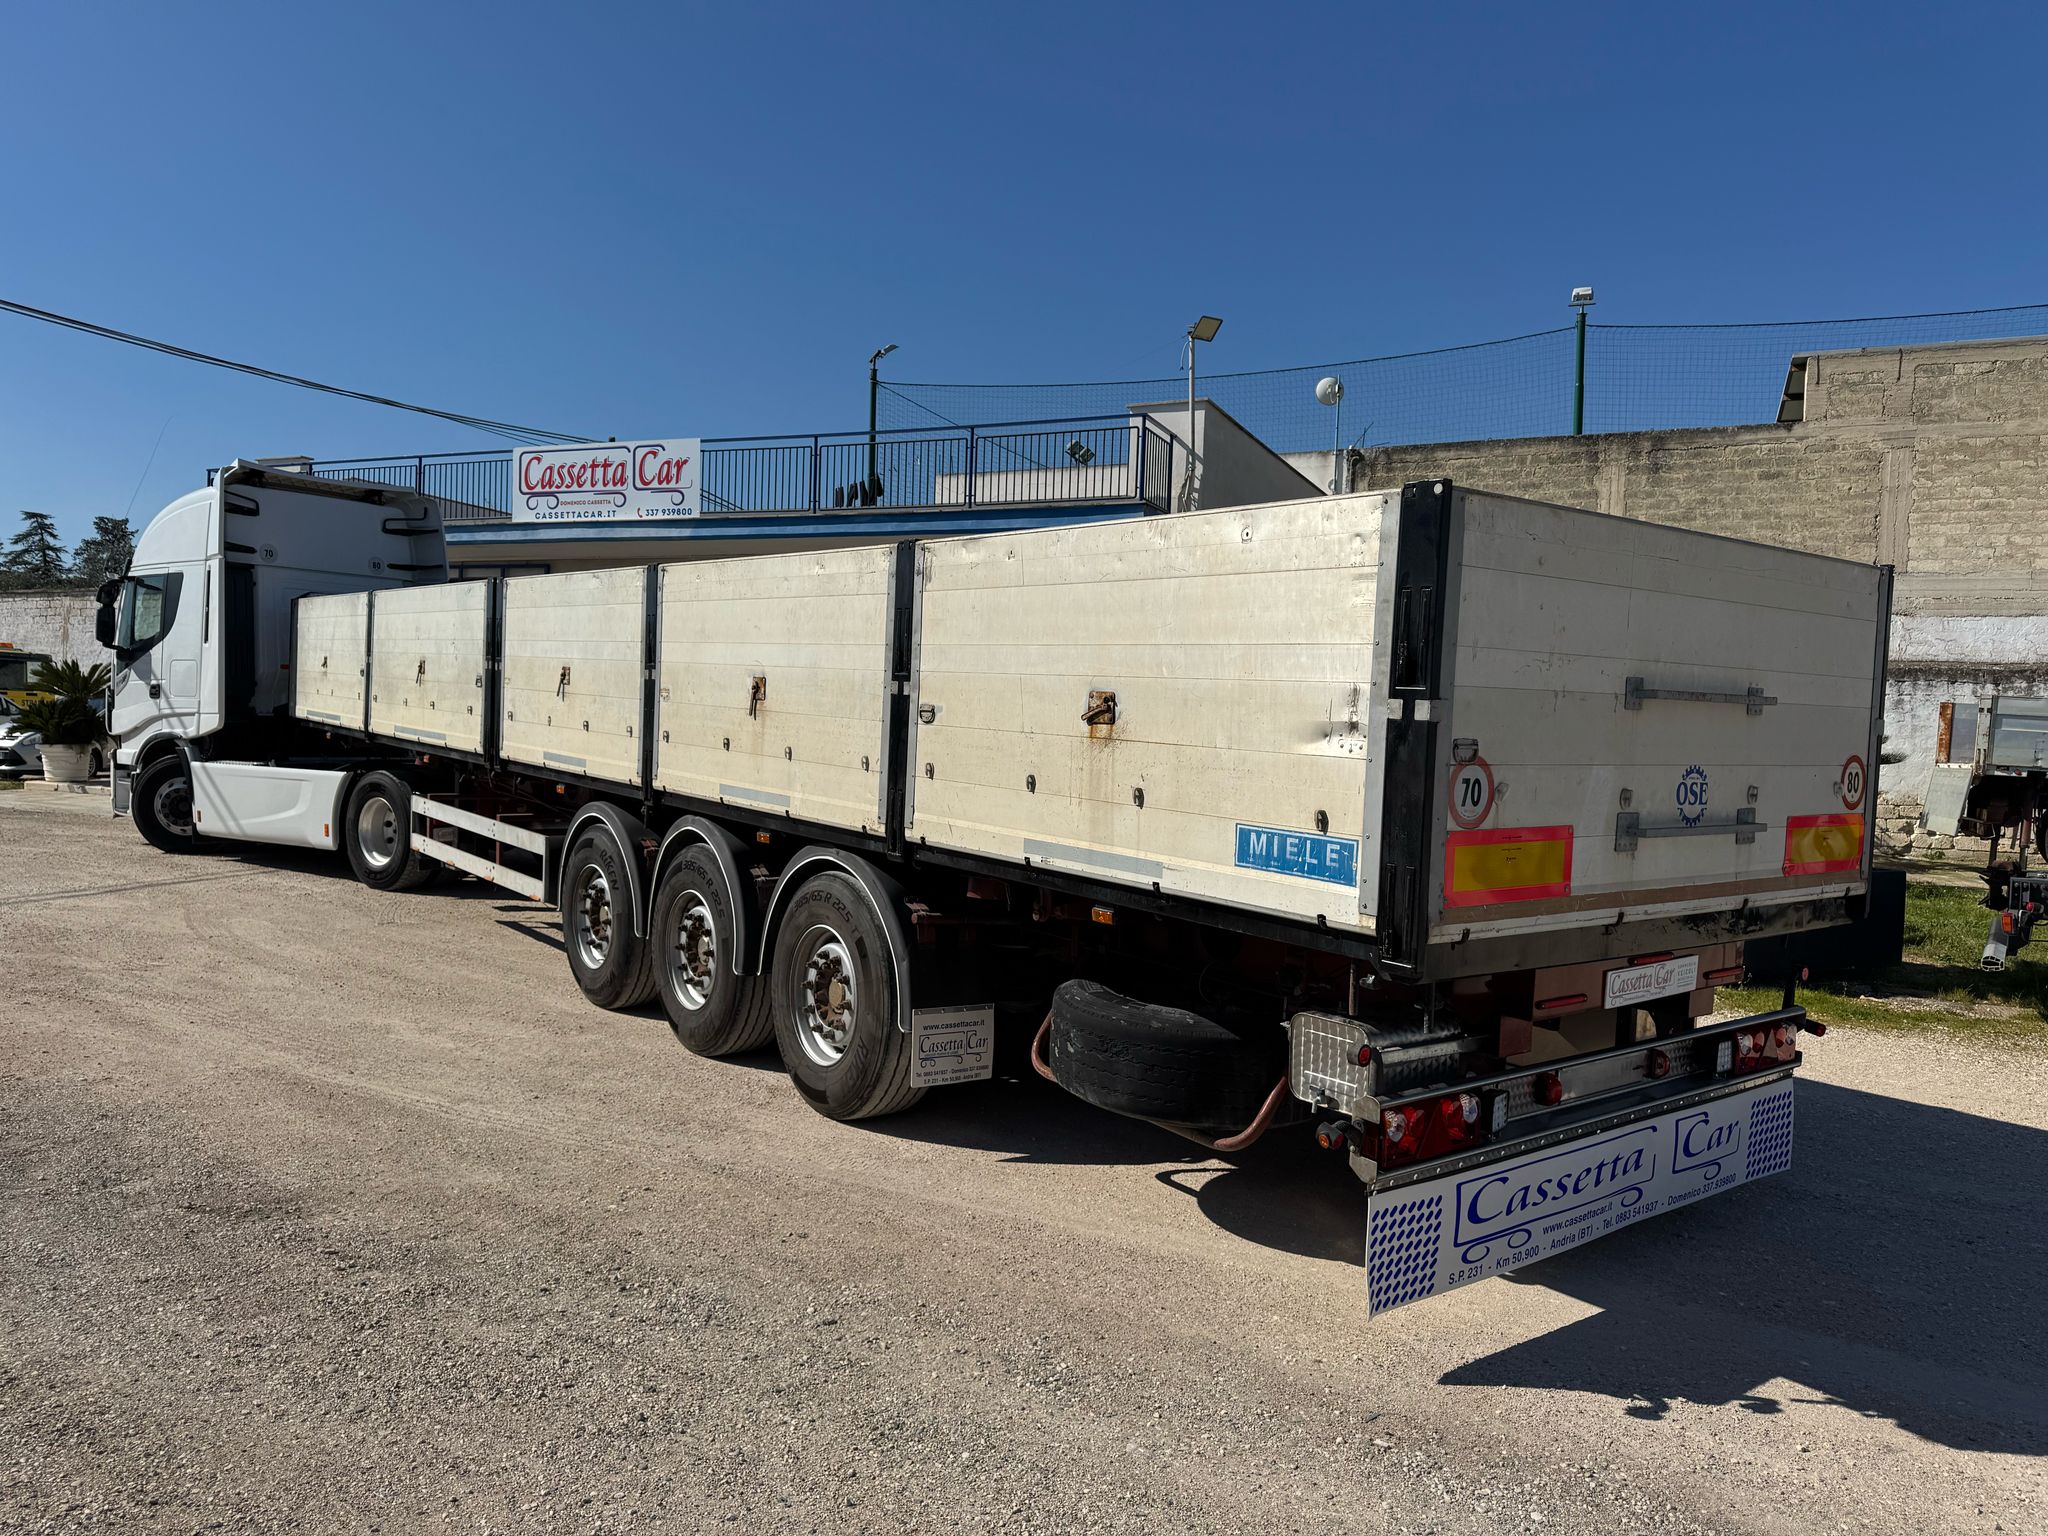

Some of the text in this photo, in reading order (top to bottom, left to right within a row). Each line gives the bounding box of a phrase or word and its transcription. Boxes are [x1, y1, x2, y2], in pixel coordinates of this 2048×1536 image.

[524, 449, 690, 491] Cassetta Car
[535, 510, 617, 519] CASSETTACAR.IT
[645, 507, 693, 517] 337 939800
[264, 549, 274, 558] 70
[1461, 778, 1481, 807] 70
[1676, 781, 1709, 806] OSE
[1847, 771, 1860, 794] 80
[1249, 832, 1341, 868] MIELE
[824, 892, 833, 904] R
[1612, 966, 1676, 995] Cassetta Car
[920, 1033, 989, 1053] Cassetta Car
[1467, 1118, 1740, 1225] Cassetta Car
[1542, 1202, 1613, 1235] www.cassettacar.it
[1448, 1270, 1465, 1285] S.P.
[1467, 1264, 1483, 1280] 231
[1496, 1256, 1510, 1270] Km
[1512, 1245, 1540, 1264] 50,900
[1550, 1232, 1576, 1251] Andria
[1577, 1224, 1593, 1241] (BT)
[1602, 1216, 1614, 1230] Tel.
[1615, 1209, 1632, 1225] 0883
[1632, 1200, 1658, 1218] 541937
[1667, 1188, 1701, 1206] Domenico
